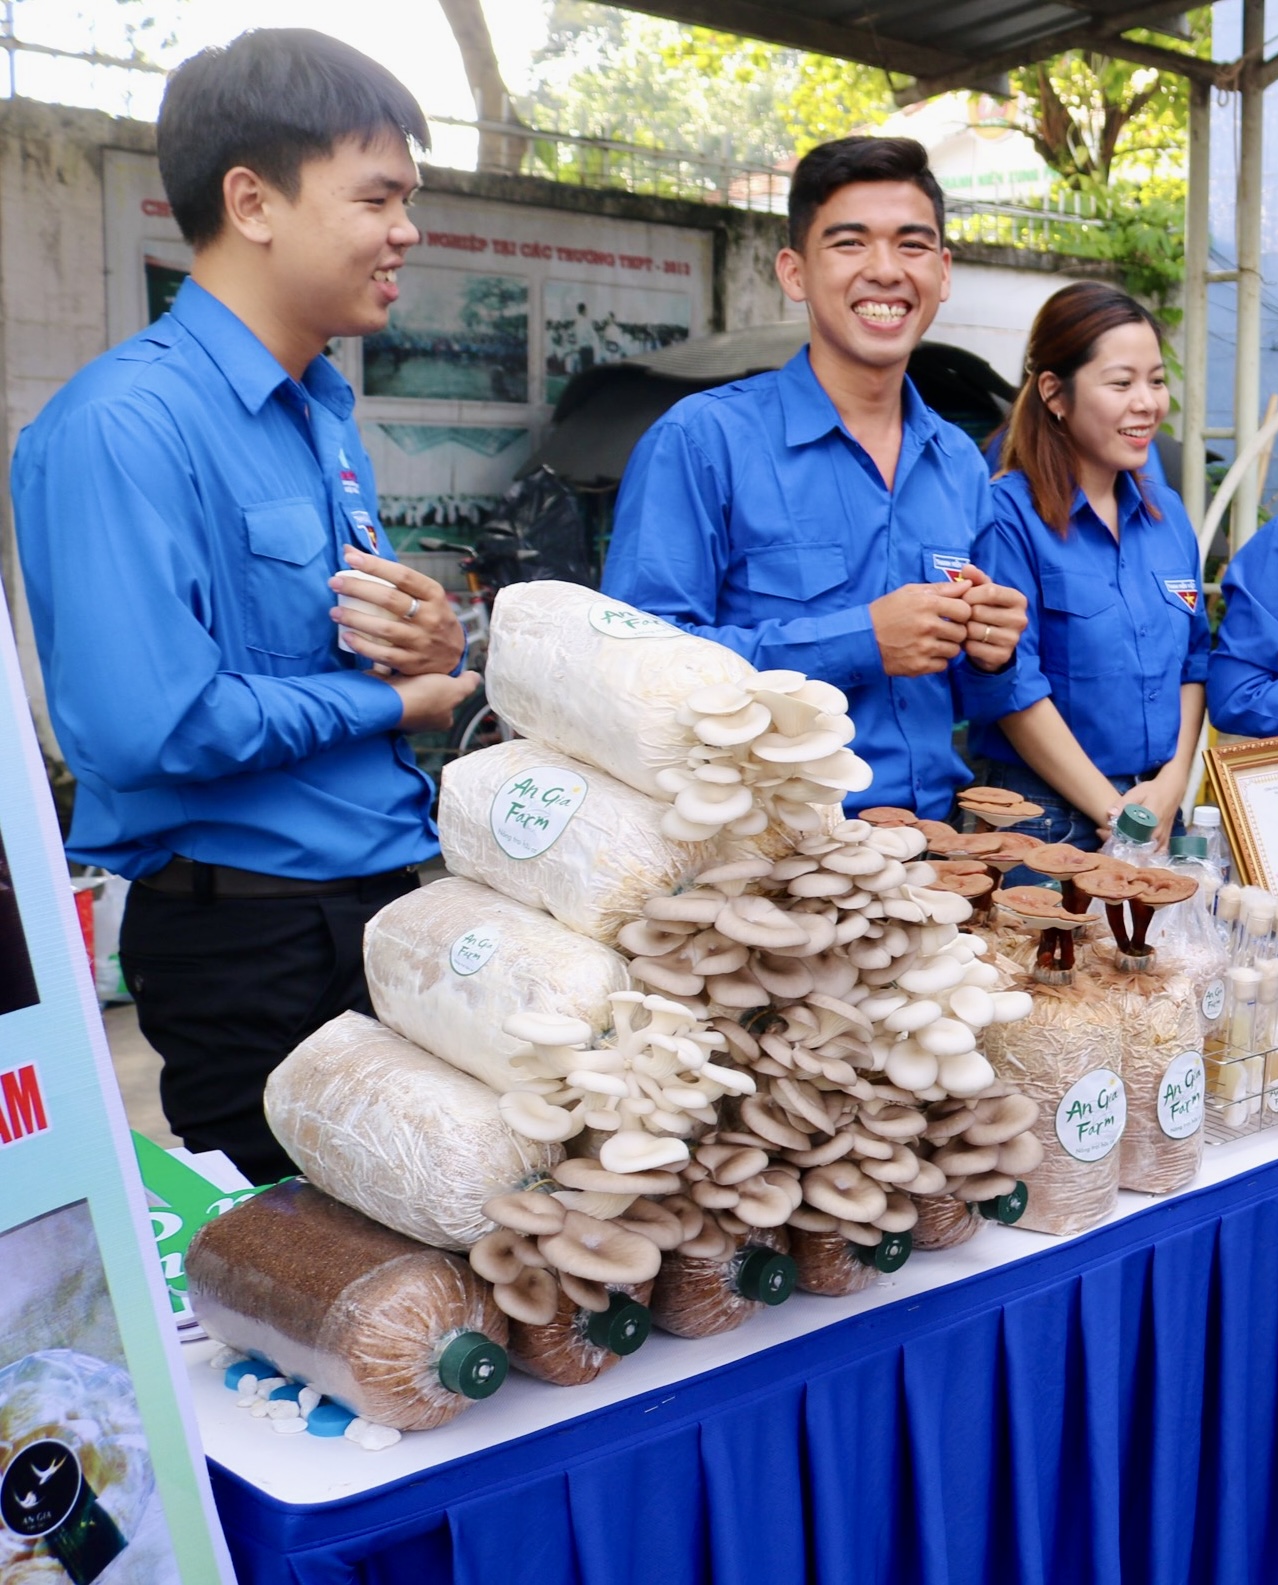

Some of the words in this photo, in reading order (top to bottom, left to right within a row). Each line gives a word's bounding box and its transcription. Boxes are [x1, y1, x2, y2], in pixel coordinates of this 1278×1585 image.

[618, 254, 653, 271] THPT
[507, 778, 539, 799] An
[541, 787, 572, 808] Gia
[505, 801, 550, 831] Farm
[458, 945, 481, 960] Farm
[461, 934, 477, 945] An
[1163, 1083, 1182, 1107] An
[1184, 1068, 1201, 1089] Gia
[1066, 1100, 1093, 1123] An
[1097, 1088, 1118, 1109] Gia
[1169, 1092, 1200, 1123] Farm
[1076, 1114, 1115, 1144] Farm
